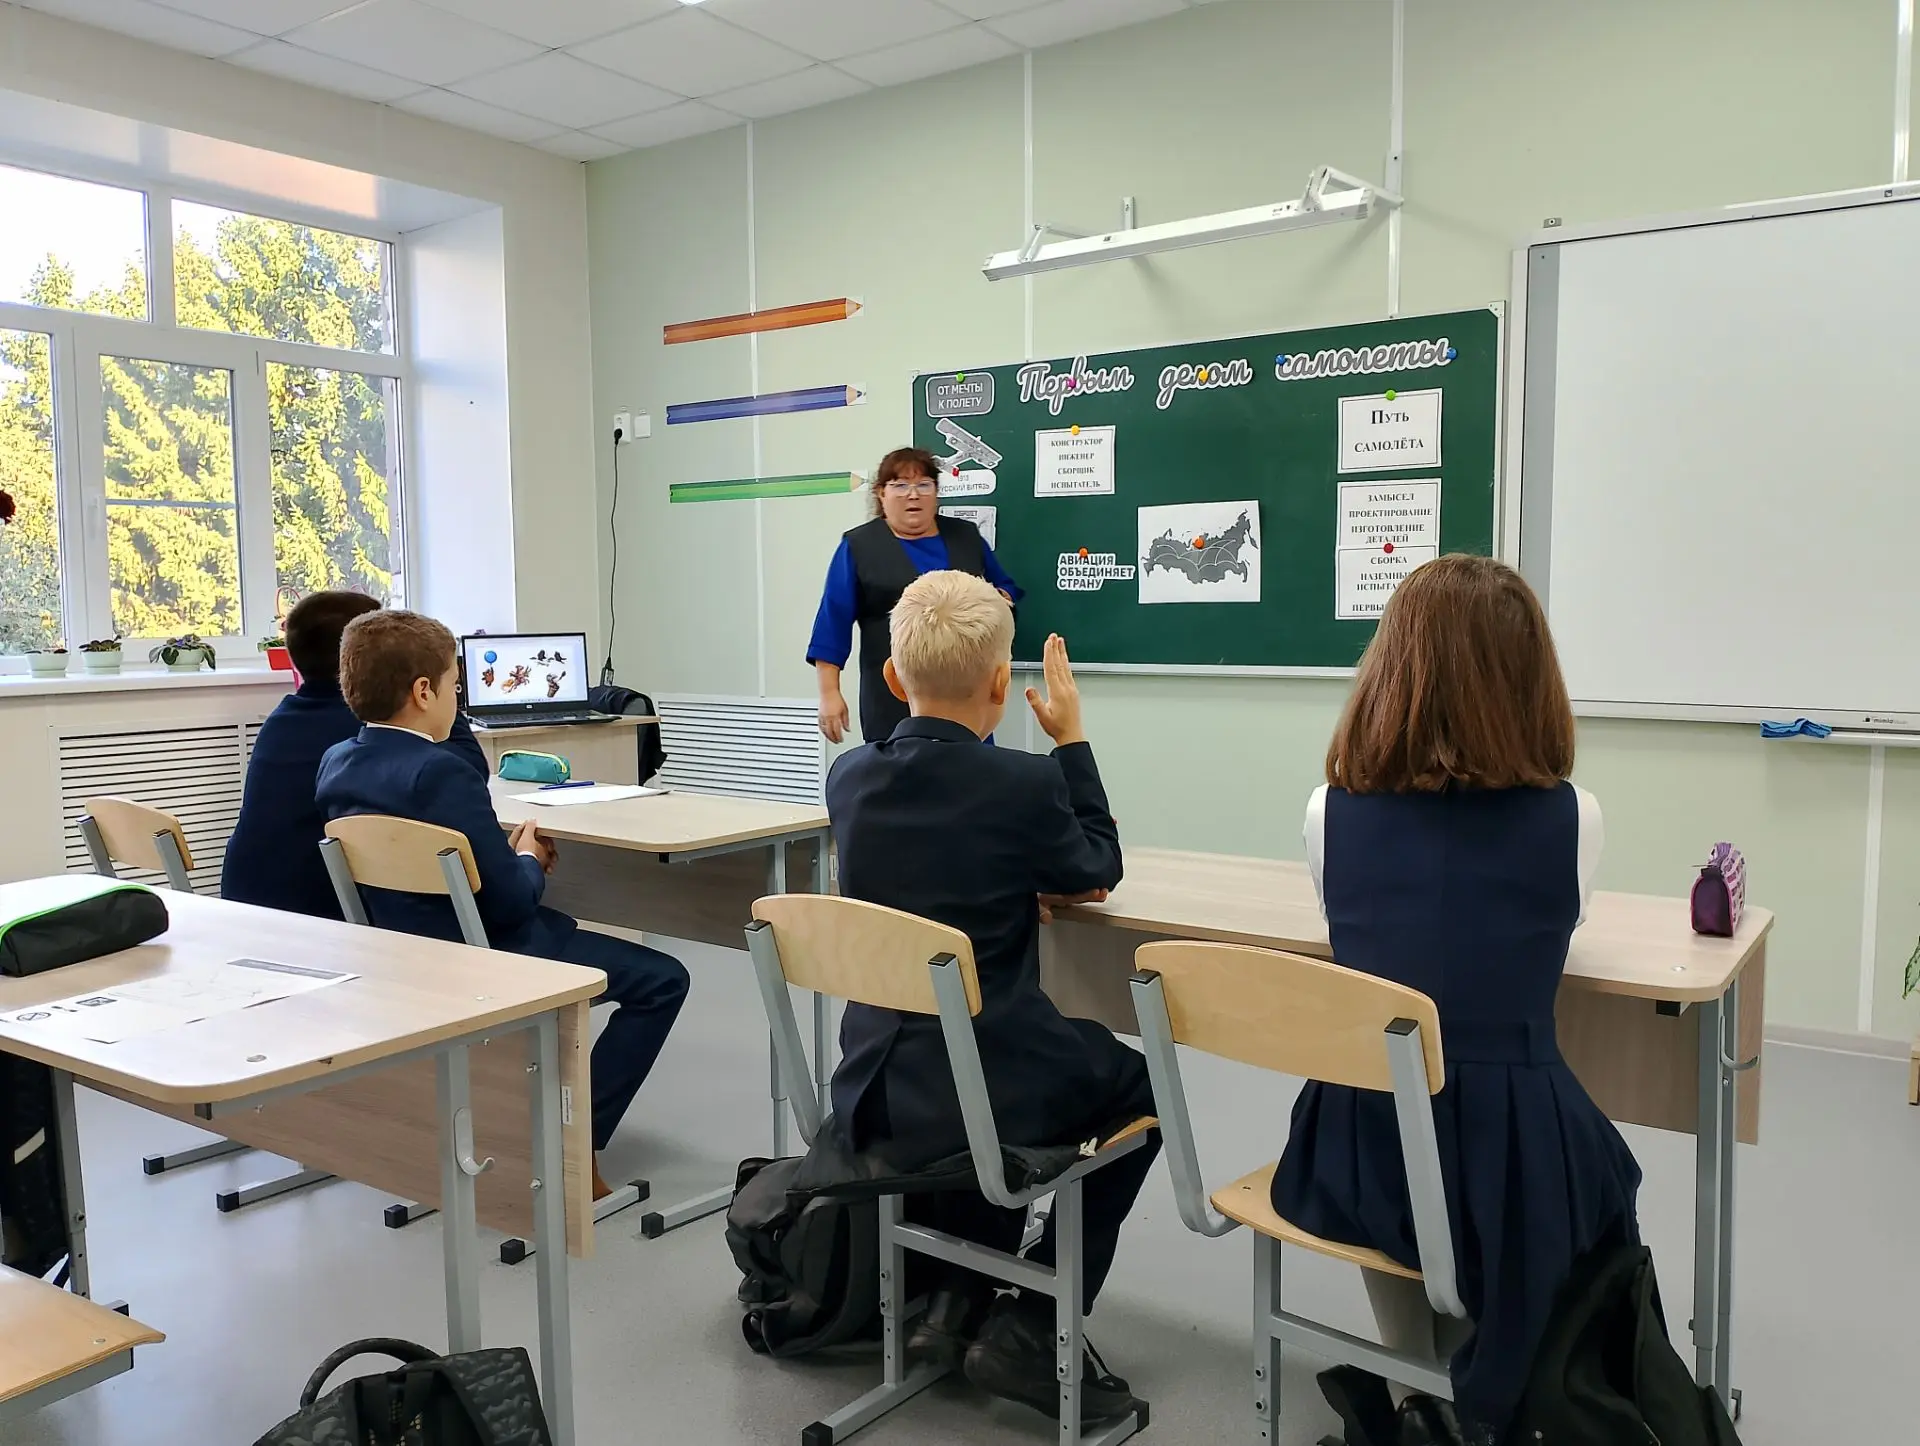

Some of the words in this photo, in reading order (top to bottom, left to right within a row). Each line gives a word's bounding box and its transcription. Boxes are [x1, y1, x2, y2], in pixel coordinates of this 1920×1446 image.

[1018, 356, 1132, 413] Первым
[1158, 360, 1249, 406] делом
[1277, 341, 1449, 377] самолеты
[937, 385, 950, 395] ОТ
[951, 382, 983, 395] МЕЧТЫ
[938, 399, 945, 409] К
[946, 397, 982, 408] ПОЛЕТУ
[1051, 438, 1103, 447] КОНСТРУКТОР
[1354, 437, 1424, 453] САМОЛЁТА
[1058, 453, 1094, 461] ИНЖЕНЕР
[1057, 466, 1095, 475] СБОРЩИК
[1051, 480, 1101, 489] ИСПЫТАТЕЛЬ
[1368, 493, 1415, 502] ЗАМЫСЕЛ
[1348, 508, 1433, 518] ПРОЕКТИРОВАНИЕ
[1351, 524, 1425, 533] ИЗГОТОВЛЕНИЕ
[1365, 534, 1409, 544] ДЕТАЛЕЙ
[1060, 555, 1114, 566] АВИАЦИЯ
[1370, 556, 1408, 565] СБОРКА
[1059, 567, 1133, 578] ОБЪЕДИНЯЕТ
[1360, 571, 1410, 581] НАЗЕМНЫ
[1059, 578, 1102, 588] СТРАНУ
[1357, 583, 1397, 591] ИСПЫТА
[1352, 604, 1385, 612] ПЕРВЫ
